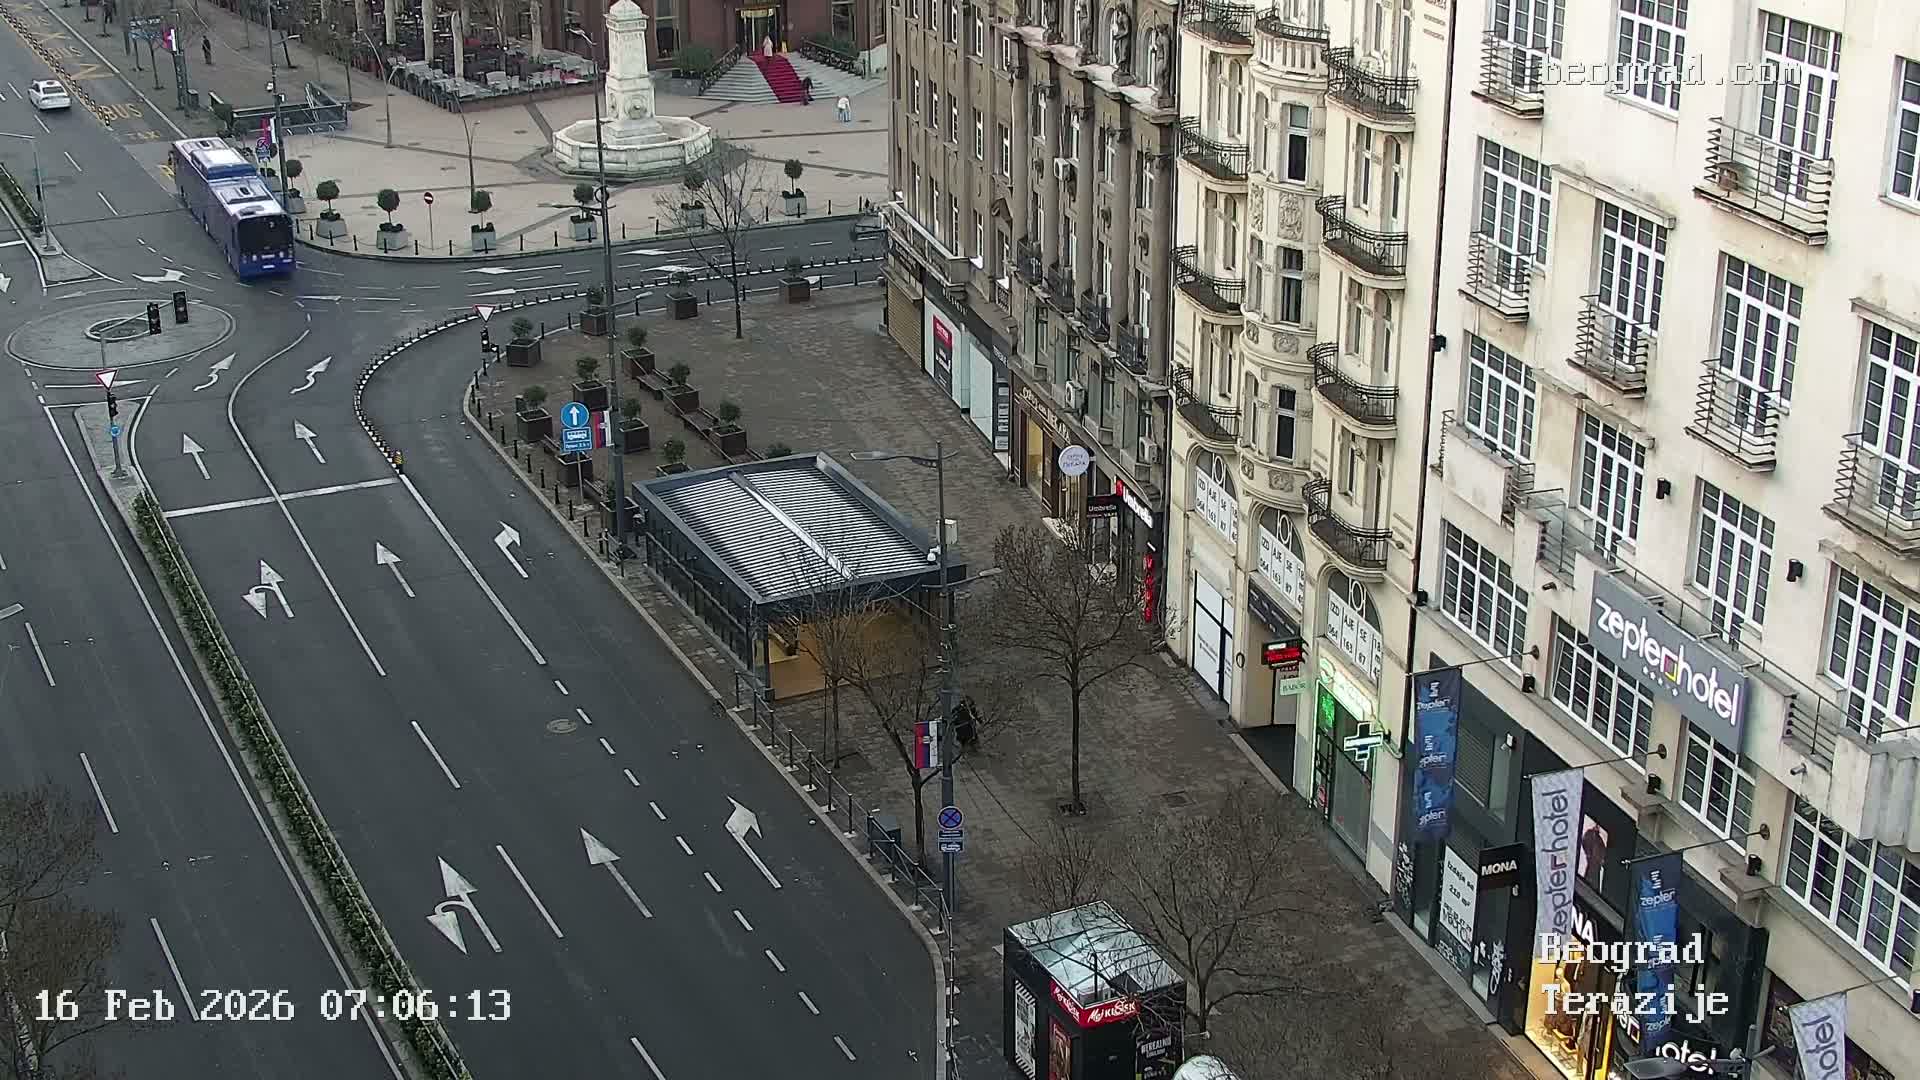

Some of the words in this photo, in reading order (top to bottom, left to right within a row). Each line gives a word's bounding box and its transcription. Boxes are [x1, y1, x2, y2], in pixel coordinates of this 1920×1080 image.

[101, 103, 143, 121] BUS
[1481, 859, 1518, 877] MONA
[1640, 890, 1676, 907] zepter
